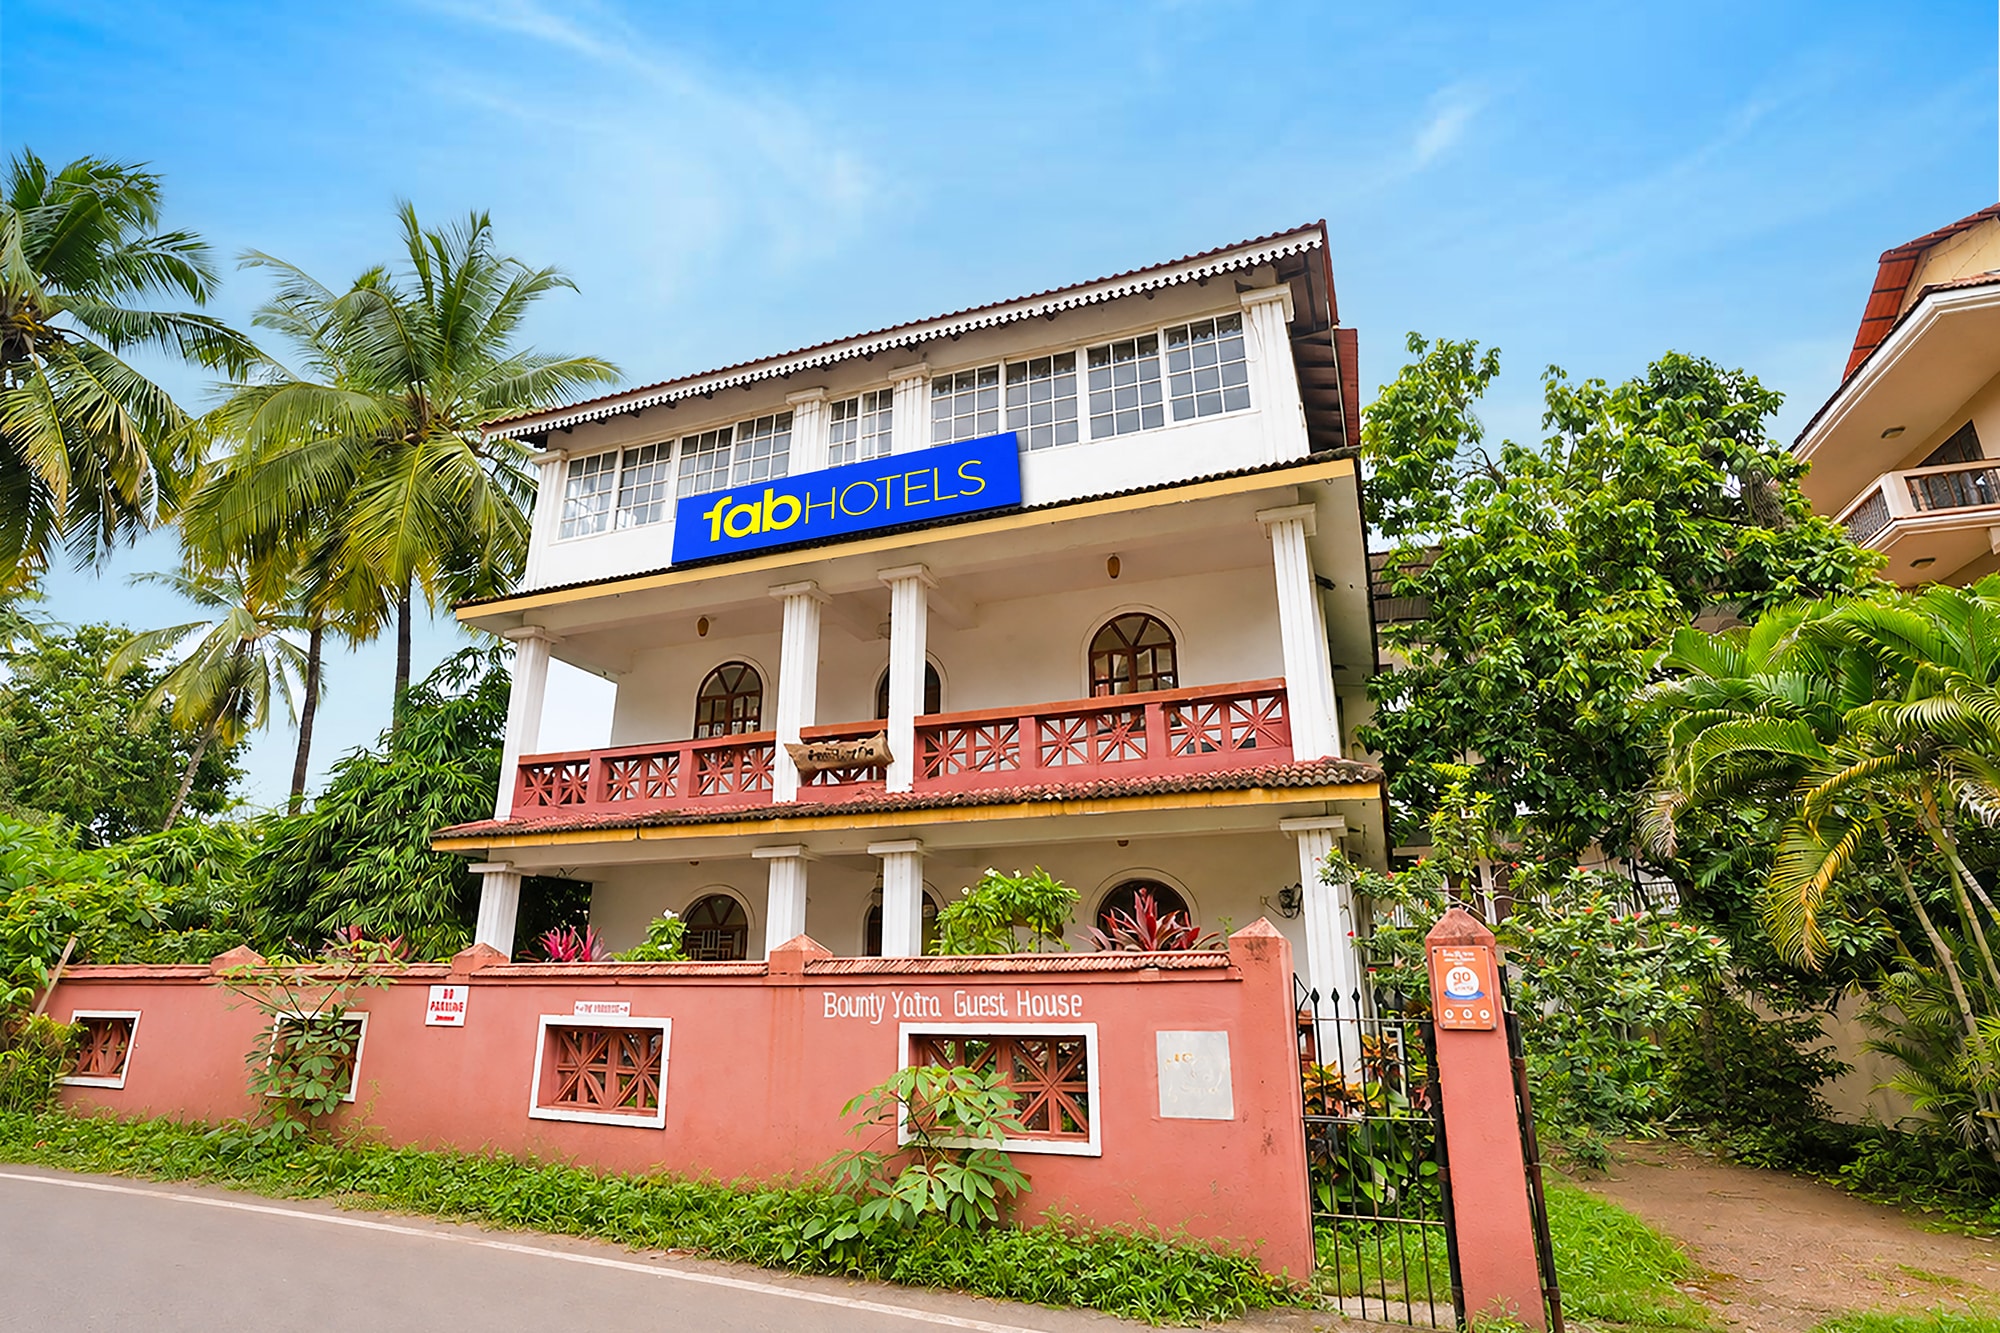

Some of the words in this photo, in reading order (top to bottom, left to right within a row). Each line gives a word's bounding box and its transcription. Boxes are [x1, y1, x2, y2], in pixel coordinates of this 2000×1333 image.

[823, 991, 886, 1025] Bounty
[891, 991, 942, 1018] Yatra
[953, 990, 1008, 1017] Guest
[1016, 990, 1083, 1017] House
